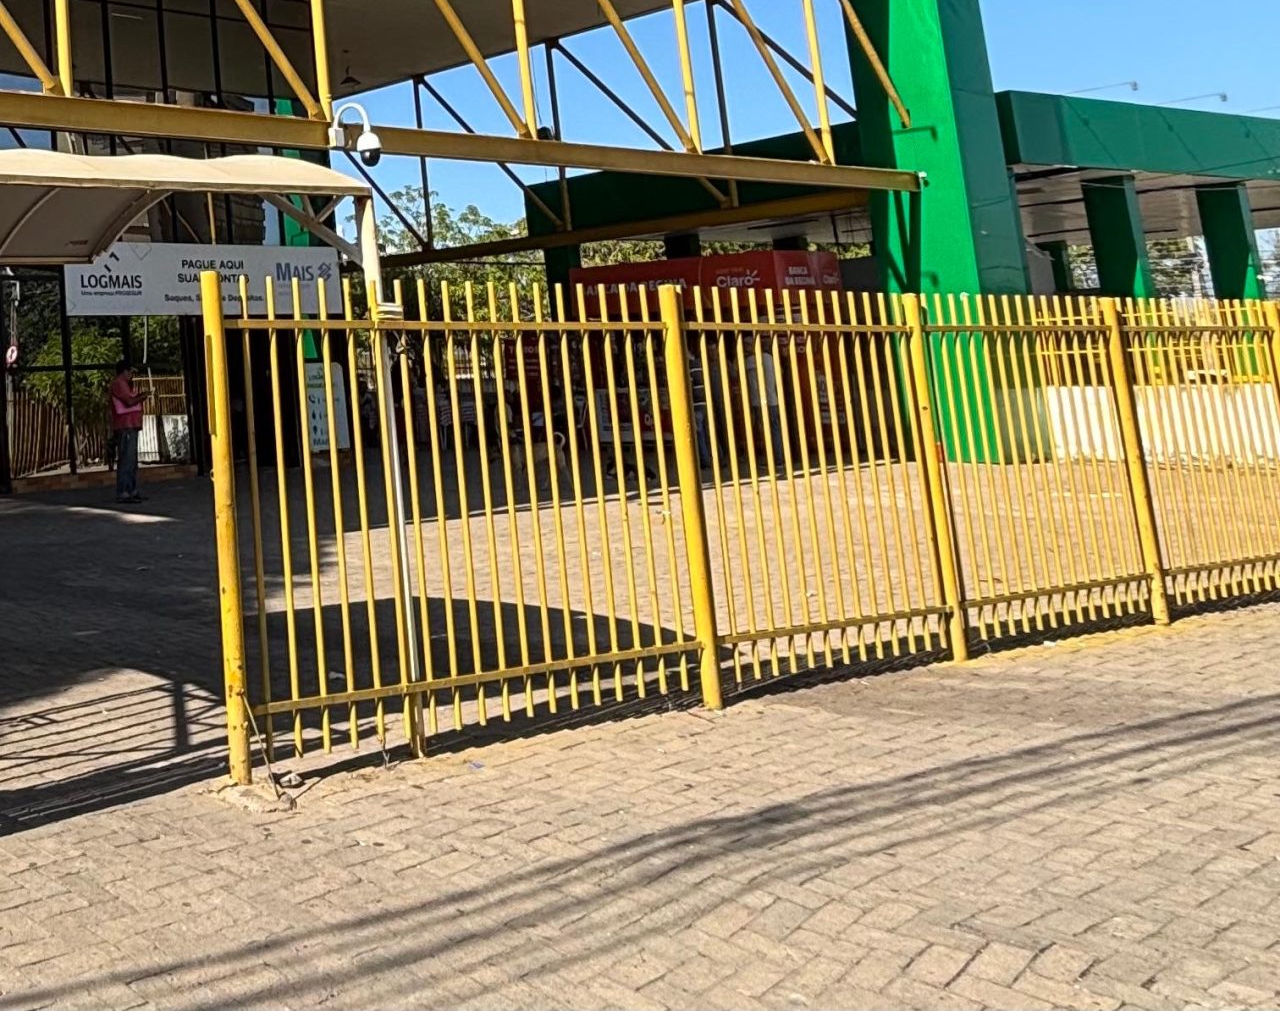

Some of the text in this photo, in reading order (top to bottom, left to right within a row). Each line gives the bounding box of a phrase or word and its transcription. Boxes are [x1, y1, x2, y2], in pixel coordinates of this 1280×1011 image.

[181, 260, 244, 269] PAGUE AQUI
[81, 274, 143, 289] LOGMAIS
[178, 274, 250, 283] SUA ONTS
[717, 276, 755, 287] Claro
